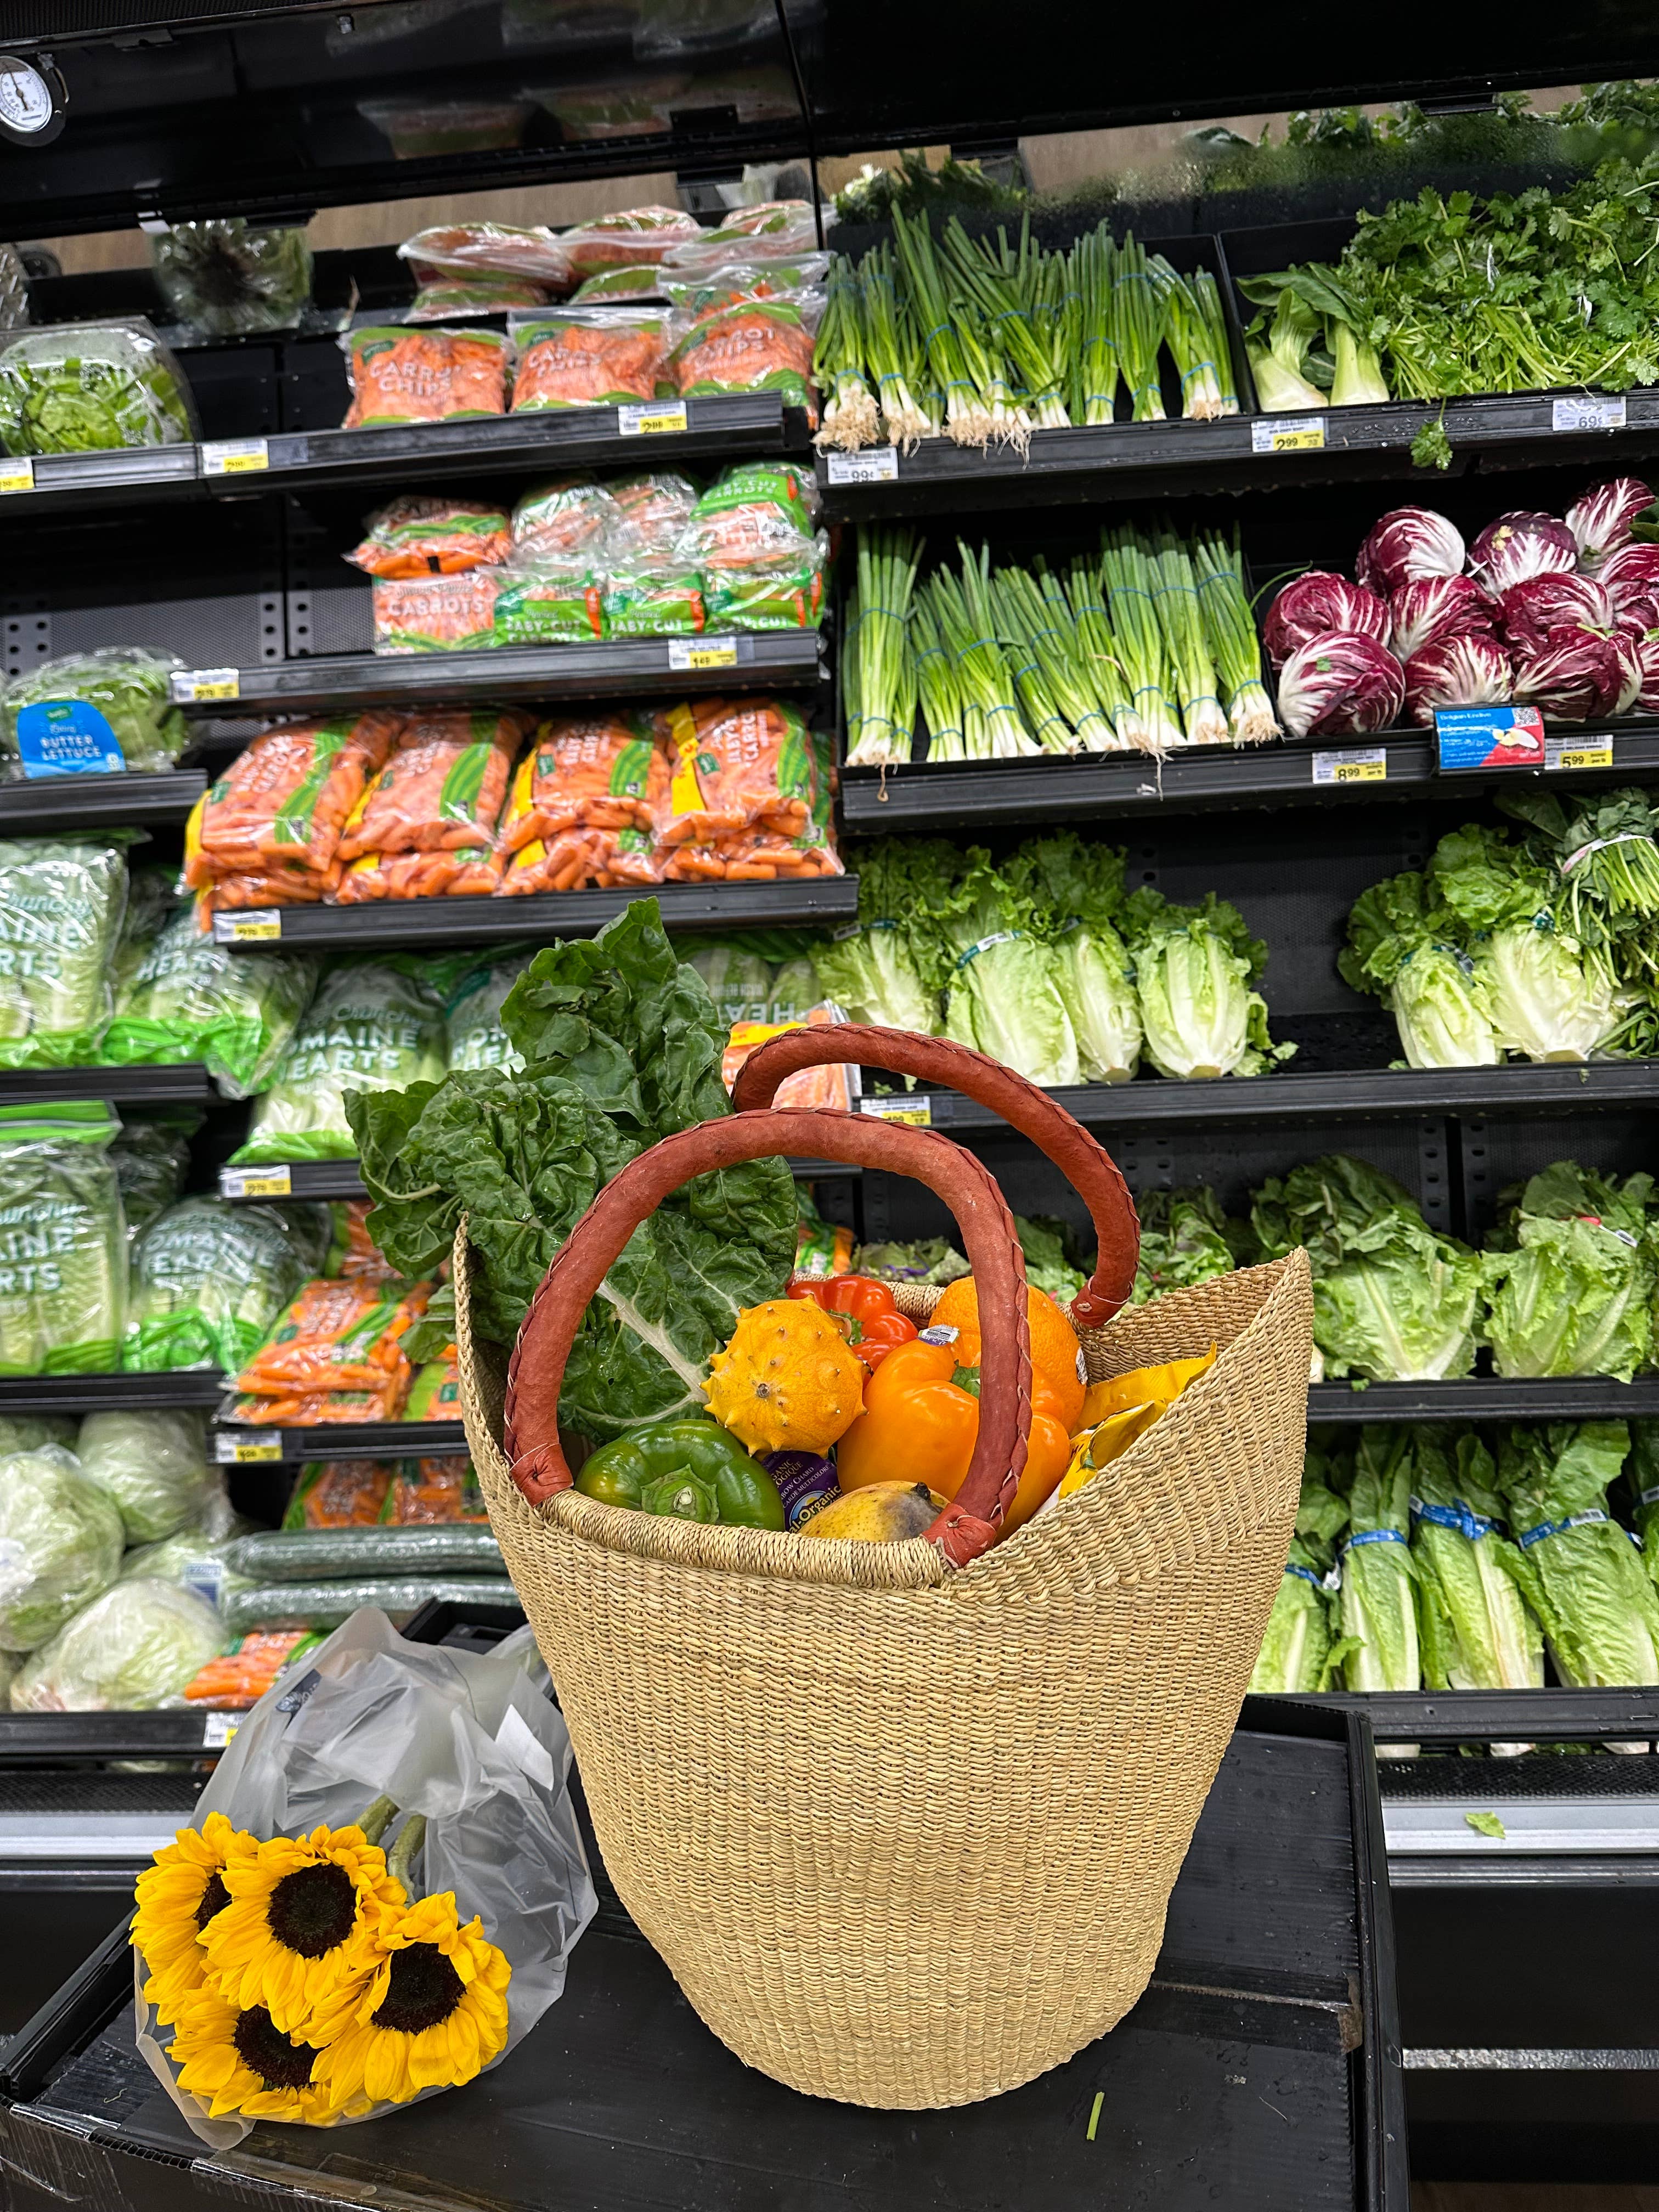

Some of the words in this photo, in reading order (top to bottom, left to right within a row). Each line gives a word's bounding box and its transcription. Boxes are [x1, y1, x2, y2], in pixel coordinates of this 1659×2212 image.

[379, 376, 453, 396] CHIPS
[1277, 437, 1298, 451] 299
[40, 734, 94, 749] BUTTER
[41, 746, 102, 761] LETTUCE
[1563, 755, 1584, 768] 599
[1339, 768, 1360, 782] 899
[716, 1002, 795, 1025] HEA
[0, 1262, 62, 1294] RTS
[776, 1461, 804, 1488] OGIQUE
[781, 1483, 794, 1500] BOW
[793, 1466, 814, 1485] CHARD
[798, 1464, 831, 1494] MULTICOLORE
